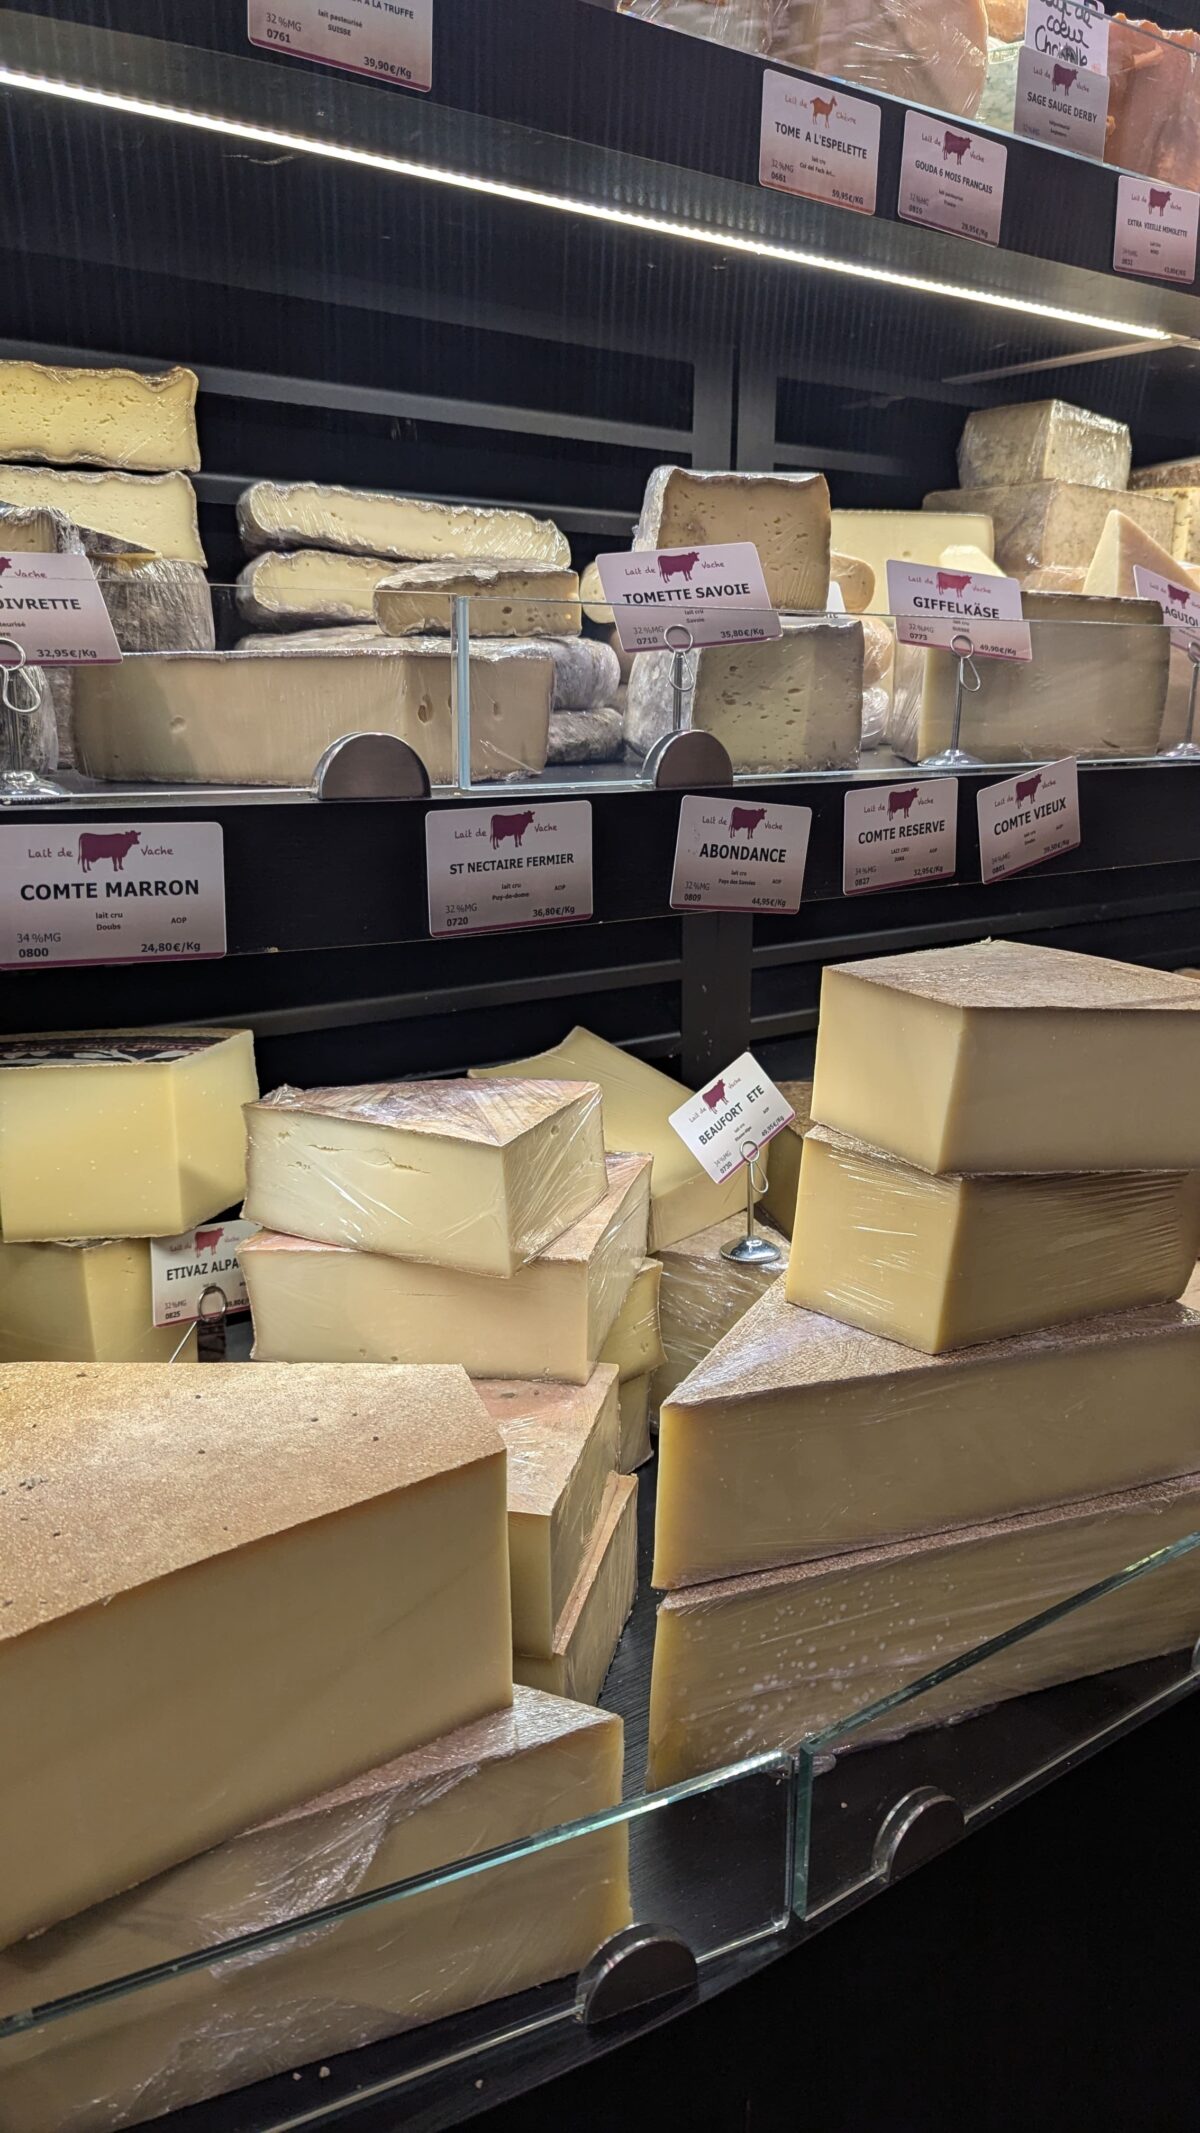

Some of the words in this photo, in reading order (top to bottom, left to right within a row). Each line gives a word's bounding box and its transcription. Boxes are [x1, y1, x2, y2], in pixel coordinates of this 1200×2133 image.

[372, 0, 382, 10] LA
[384, 3, 414, 19] TRUFFE
[267, 29, 291, 43] 0761
[328, 24, 351, 36] SUISSE
[364, 57, 412, 79] 39,90€/Kg
[1027, 92, 1046, 106] SAGE
[1048, 99, 1072, 115] SAUGE
[1074, 108, 1097, 122] DERBY
[775, 122, 800, 139] TOME
[805, 132, 811, 142] A
[814, 134, 867, 159] L'ESPELETTE
[915, 160, 938, 175] GOUDA
[939, 169, 943, 177] 6
[945, 171, 962, 183] MOIS
[962, 177, 993, 194] FRANCAIS
[1128, 219, 1142, 228] EXTRA
[1163, 226, 1187, 238] MIMOLETTE
[14, 569, 47, 578] Vache
[625, 568, 642, 576] Lait
[645, 567, 656, 575] de
[623, 589, 692, 604] TOMETTE
[696, 583, 751, 599] SAVOIE
[913, 596, 999, 619] GIFFELKÄSE
[720, 628, 765, 639] 35,80€/Kg
[909, 633, 928, 641] 0773
[637, 637, 658, 645] 0710
[37, 649, 97, 658] 32,95€/Kg
[864, 805, 876, 813] Lait
[878, 803, 886, 811] de
[994, 811, 1031, 835] COMTE
[1034, 797, 1067, 820] VIEUX
[702, 816, 716, 824] Lait
[718, 817, 727, 825] de
[764, 822, 783, 831] Vache
[454, 830, 472, 839] Lait
[476, 828, 487, 837] de
[534, 824, 558, 832] Vache
[858, 828, 896, 844] COMTE
[899, 820, 945, 838] RESERVE
[28, 849, 52, 859] Lait
[57, 848, 73, 858] de
[141, 845, 174, 856] Vache
[699, 843, 787, 863] ABONDANCE
[450, 863, 465, 875] ST
[467, 857, 524, 874] NECTAIRE
[526, 853, 575, 868] FERMIER
[20, 882, 98, 901] COMTE
[106, 879, 199, 898] MARRON
[684, 893, 701, 901] 0809
[752, 897, 786, 907] 44,95€/Kg
[96, 911, 109, 919] lait
[533, 905, 575, 918] 36,80€/Kg
[96, 923, 121, 931] Doubs
[447, 916, 469, 927] 0720
[16, 933, 30, 943] 34
[19, 948, 49, 958] 0800
[141, 941, 201, 953] 24,80€/Kg
[699, 1102, 744, 1146] BEAUFORT
[746, 1085, 765, 1104] ETE
[720, 1162, 733, 1174] 0730
[167, 1263, 208, 1281] ETIVAZ
